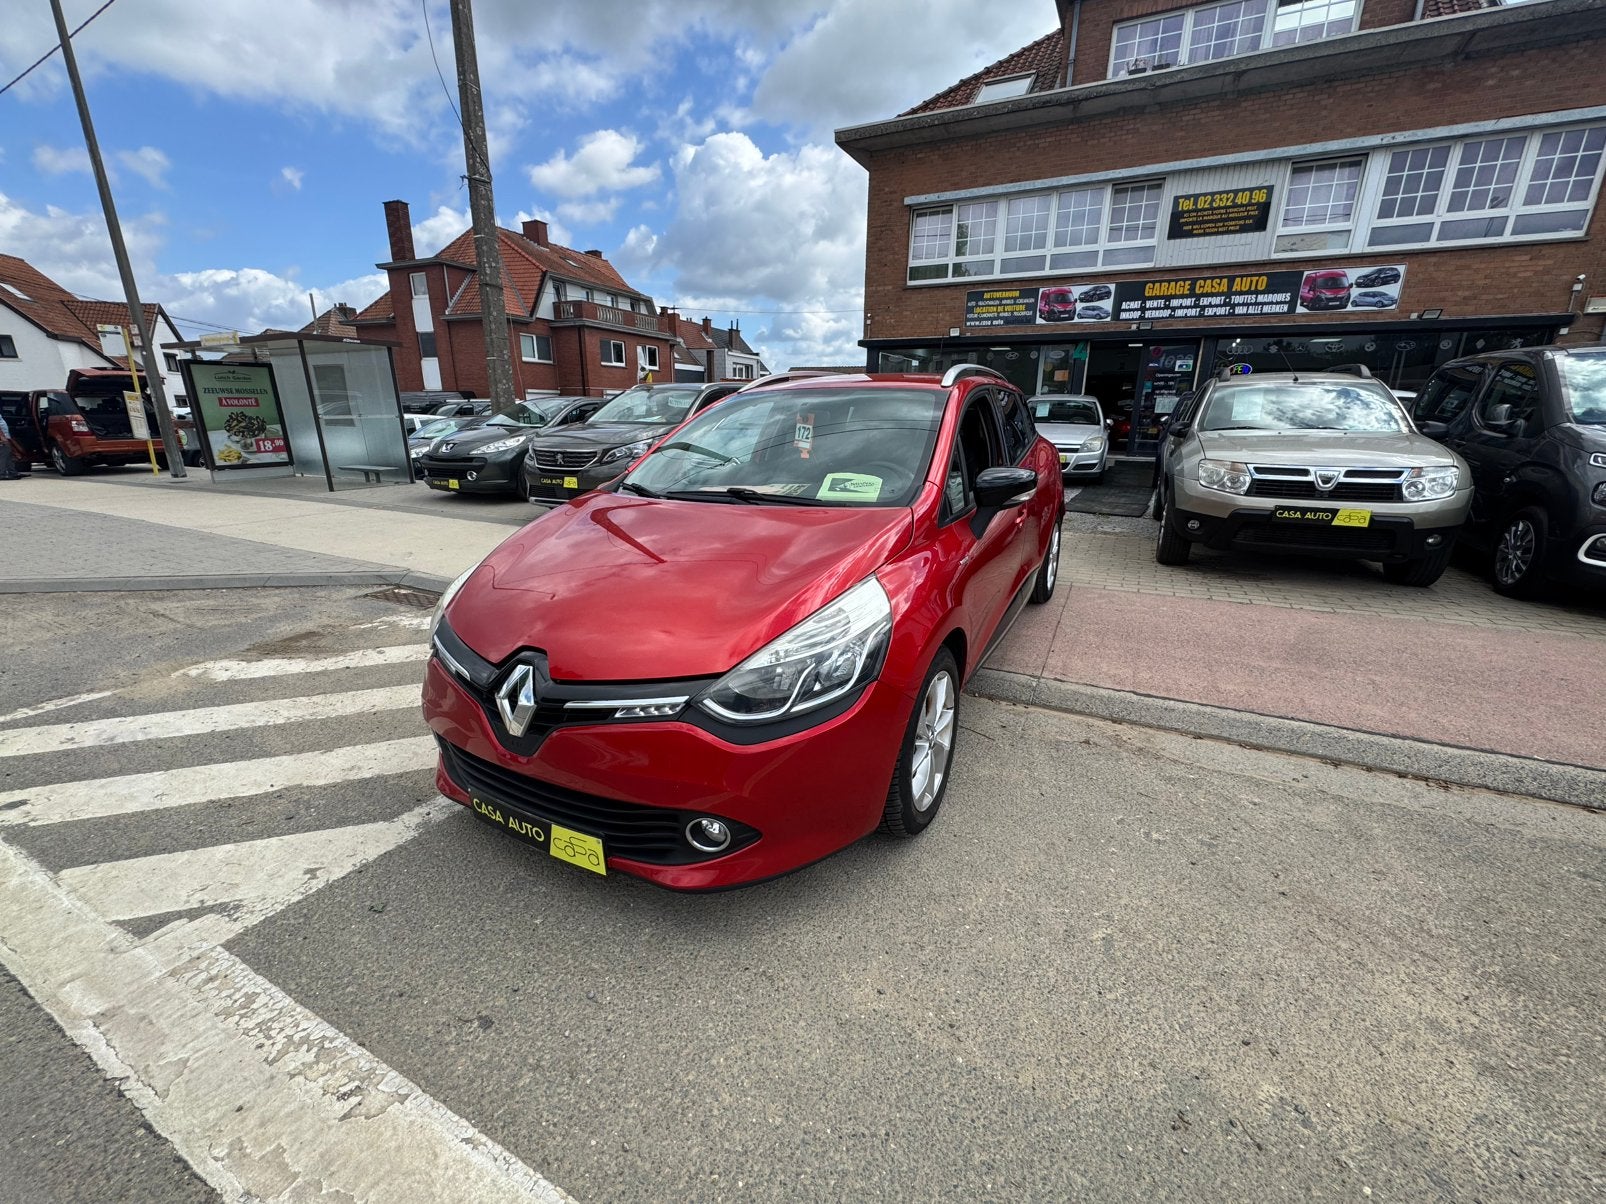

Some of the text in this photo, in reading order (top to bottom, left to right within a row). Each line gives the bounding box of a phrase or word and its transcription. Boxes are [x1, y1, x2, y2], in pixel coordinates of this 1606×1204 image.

[1178, 188, 1267, 211] Tel. 02 332 40 96
[1144, 275, 1268, 297] GARAGE CASA AUTO
[997, 305, 1004, 313] DE
[1120, 292, 1291, 310] ACHAT VENTE IMPORT EXPORT TOUTES MARQUES
[1119, 303, 1289, 320] INKOOP VERKOOP IMPORT EXPORT VAN ALLE MERKEN
[202, 387, 269, 395] ZEEUWSE MOSSELEN
[228, 397, 258, 406] VOLONTÉ
[797, 425, 811, 440] 172
[1276, 510, 1302, 519] CASA
[1304, 511, 1332, 520] AUTO
[473, 798, 505, 825] CASA
[508, 816, 545, 842] AUTO
